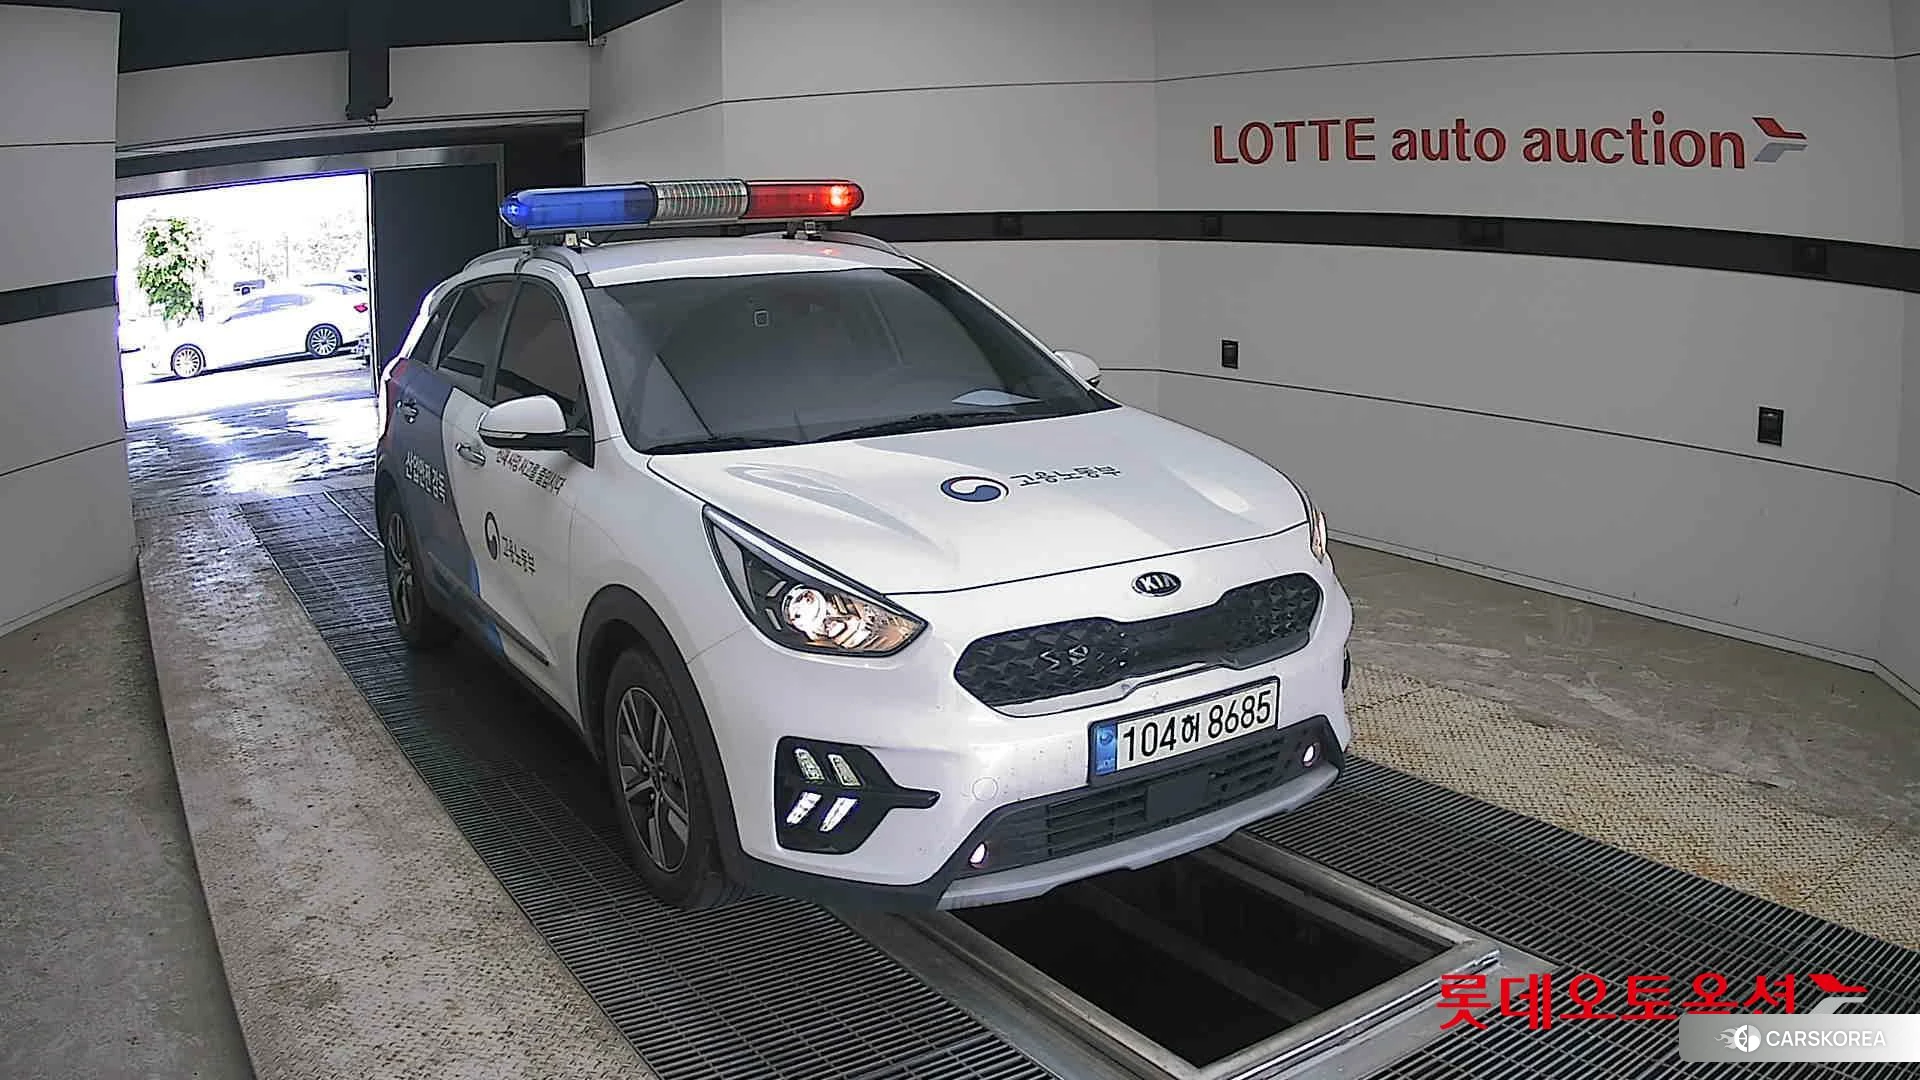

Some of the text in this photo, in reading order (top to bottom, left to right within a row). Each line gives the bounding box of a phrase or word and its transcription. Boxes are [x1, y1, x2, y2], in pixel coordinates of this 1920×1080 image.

[1212, 110, 1746, 170] LOTTE auto auction
[1010, 463, 1121, 487] 고용노동부
[1140, 573, 1178, 594] KIA
[1122, 689, 1272, 762] 104허 8685
